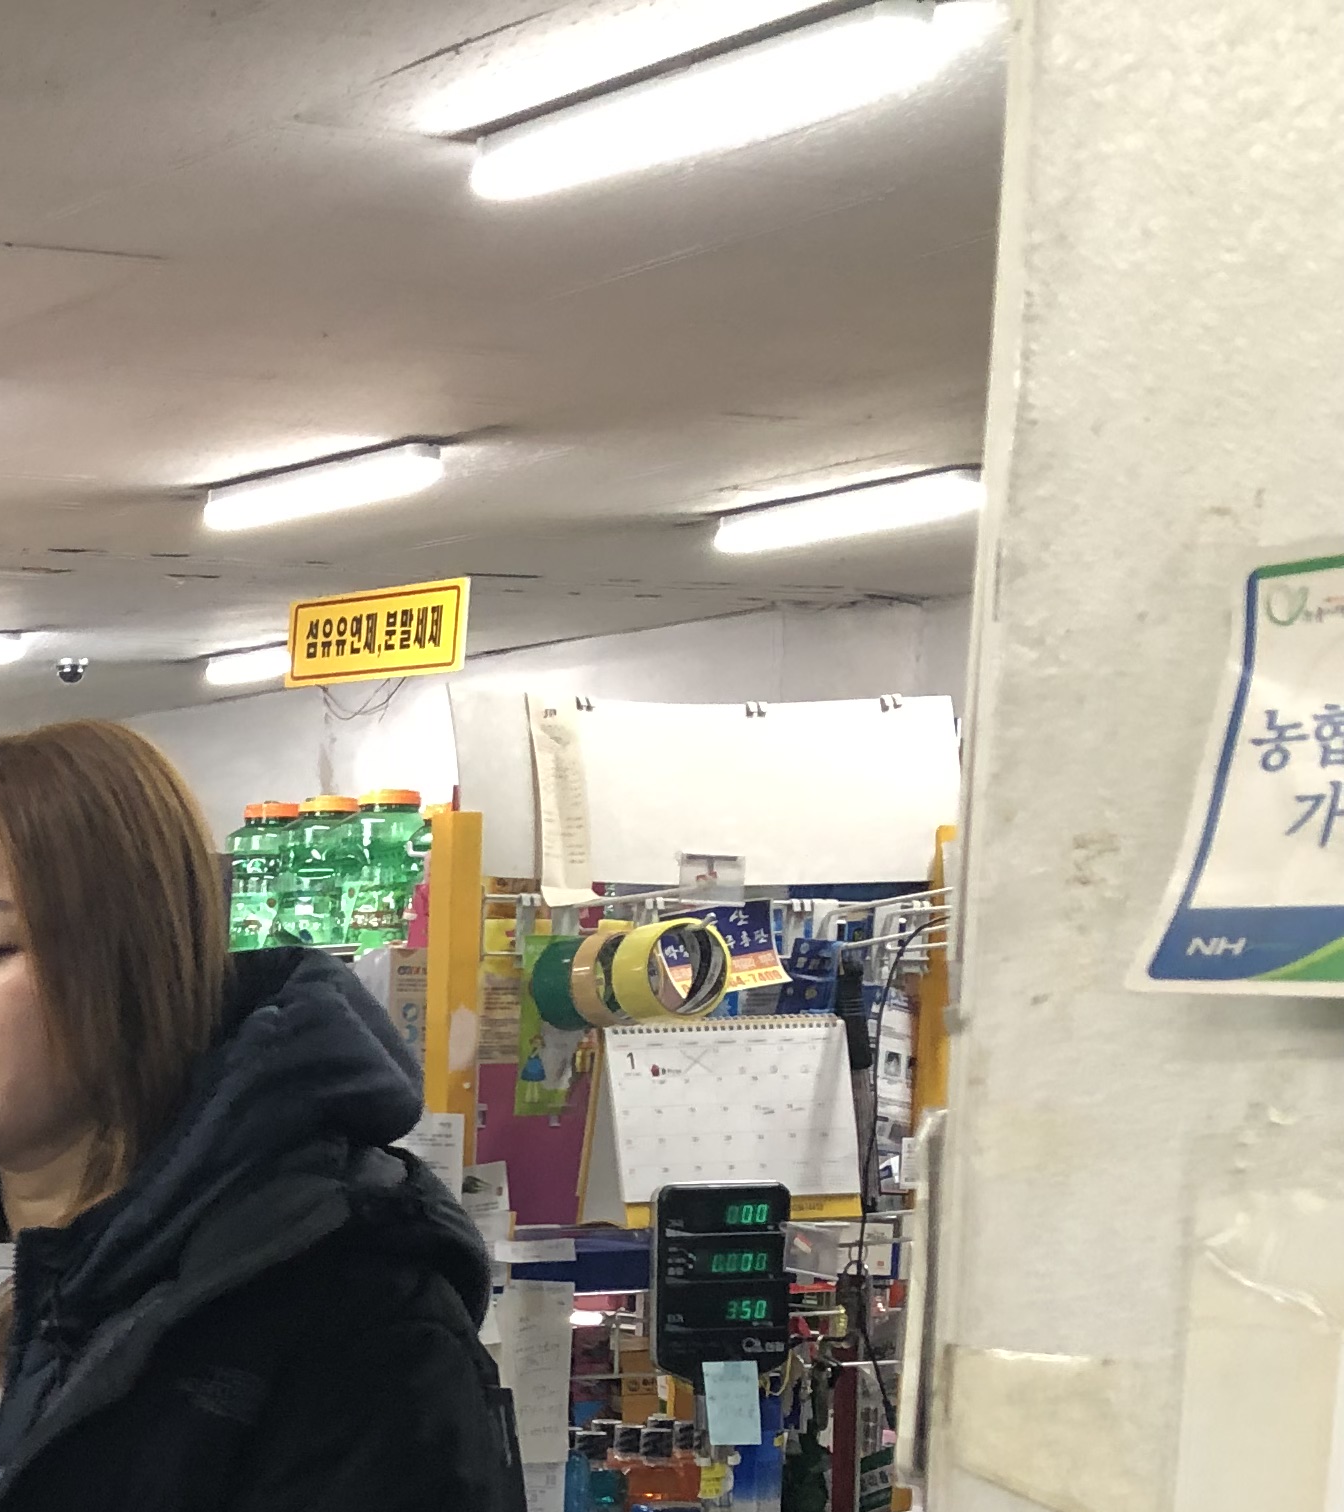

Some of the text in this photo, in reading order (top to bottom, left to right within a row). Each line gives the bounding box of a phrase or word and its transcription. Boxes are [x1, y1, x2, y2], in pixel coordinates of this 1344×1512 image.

[1186, 937, 1246, 956] NH
[626, 1052, 636, 1070] 1
[727, 1300, 768, 1320] 350
